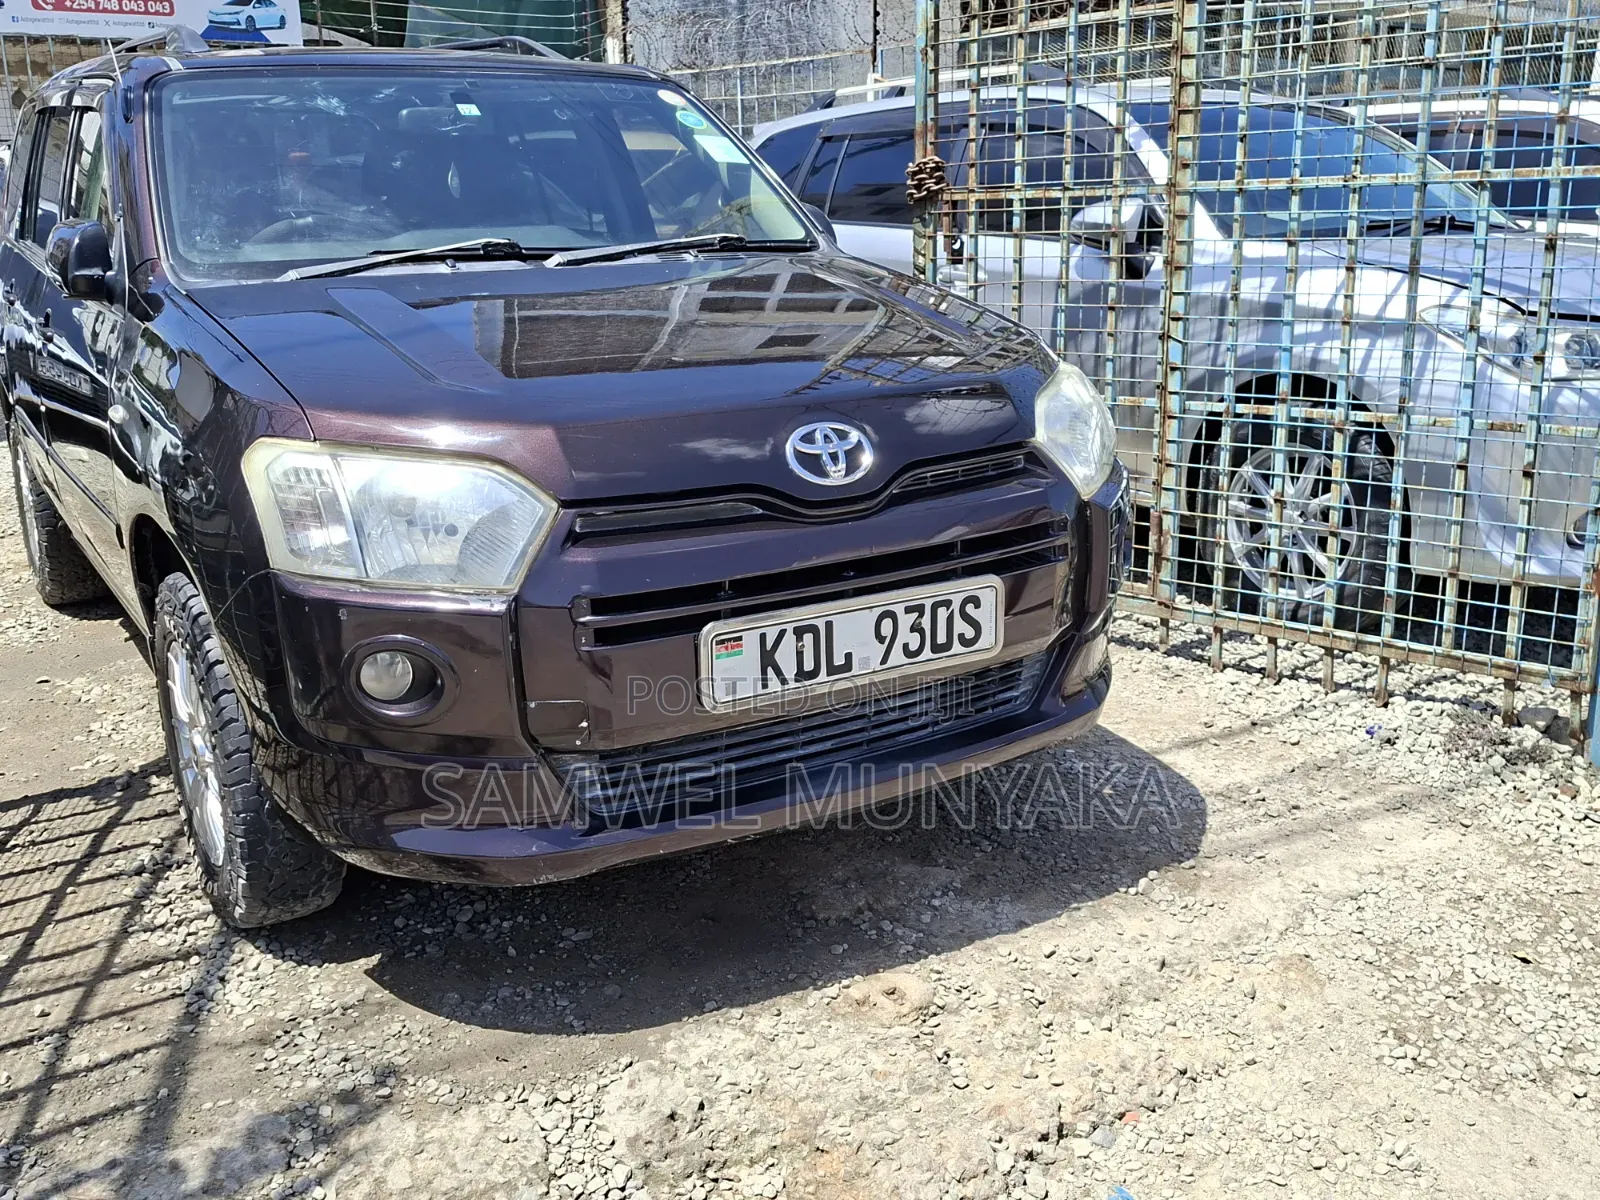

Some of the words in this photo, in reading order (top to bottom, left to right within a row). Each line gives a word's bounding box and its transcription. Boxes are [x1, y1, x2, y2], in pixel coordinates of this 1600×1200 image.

[64, 0, 96, 10] +254
[98, 0, 120, 11] 748
[122, 0, 146, 12] 043
[147, 1, 171, 13] 043
[759, 620, 853, 690] KDL
[874, 594, 983, 666] 930S
